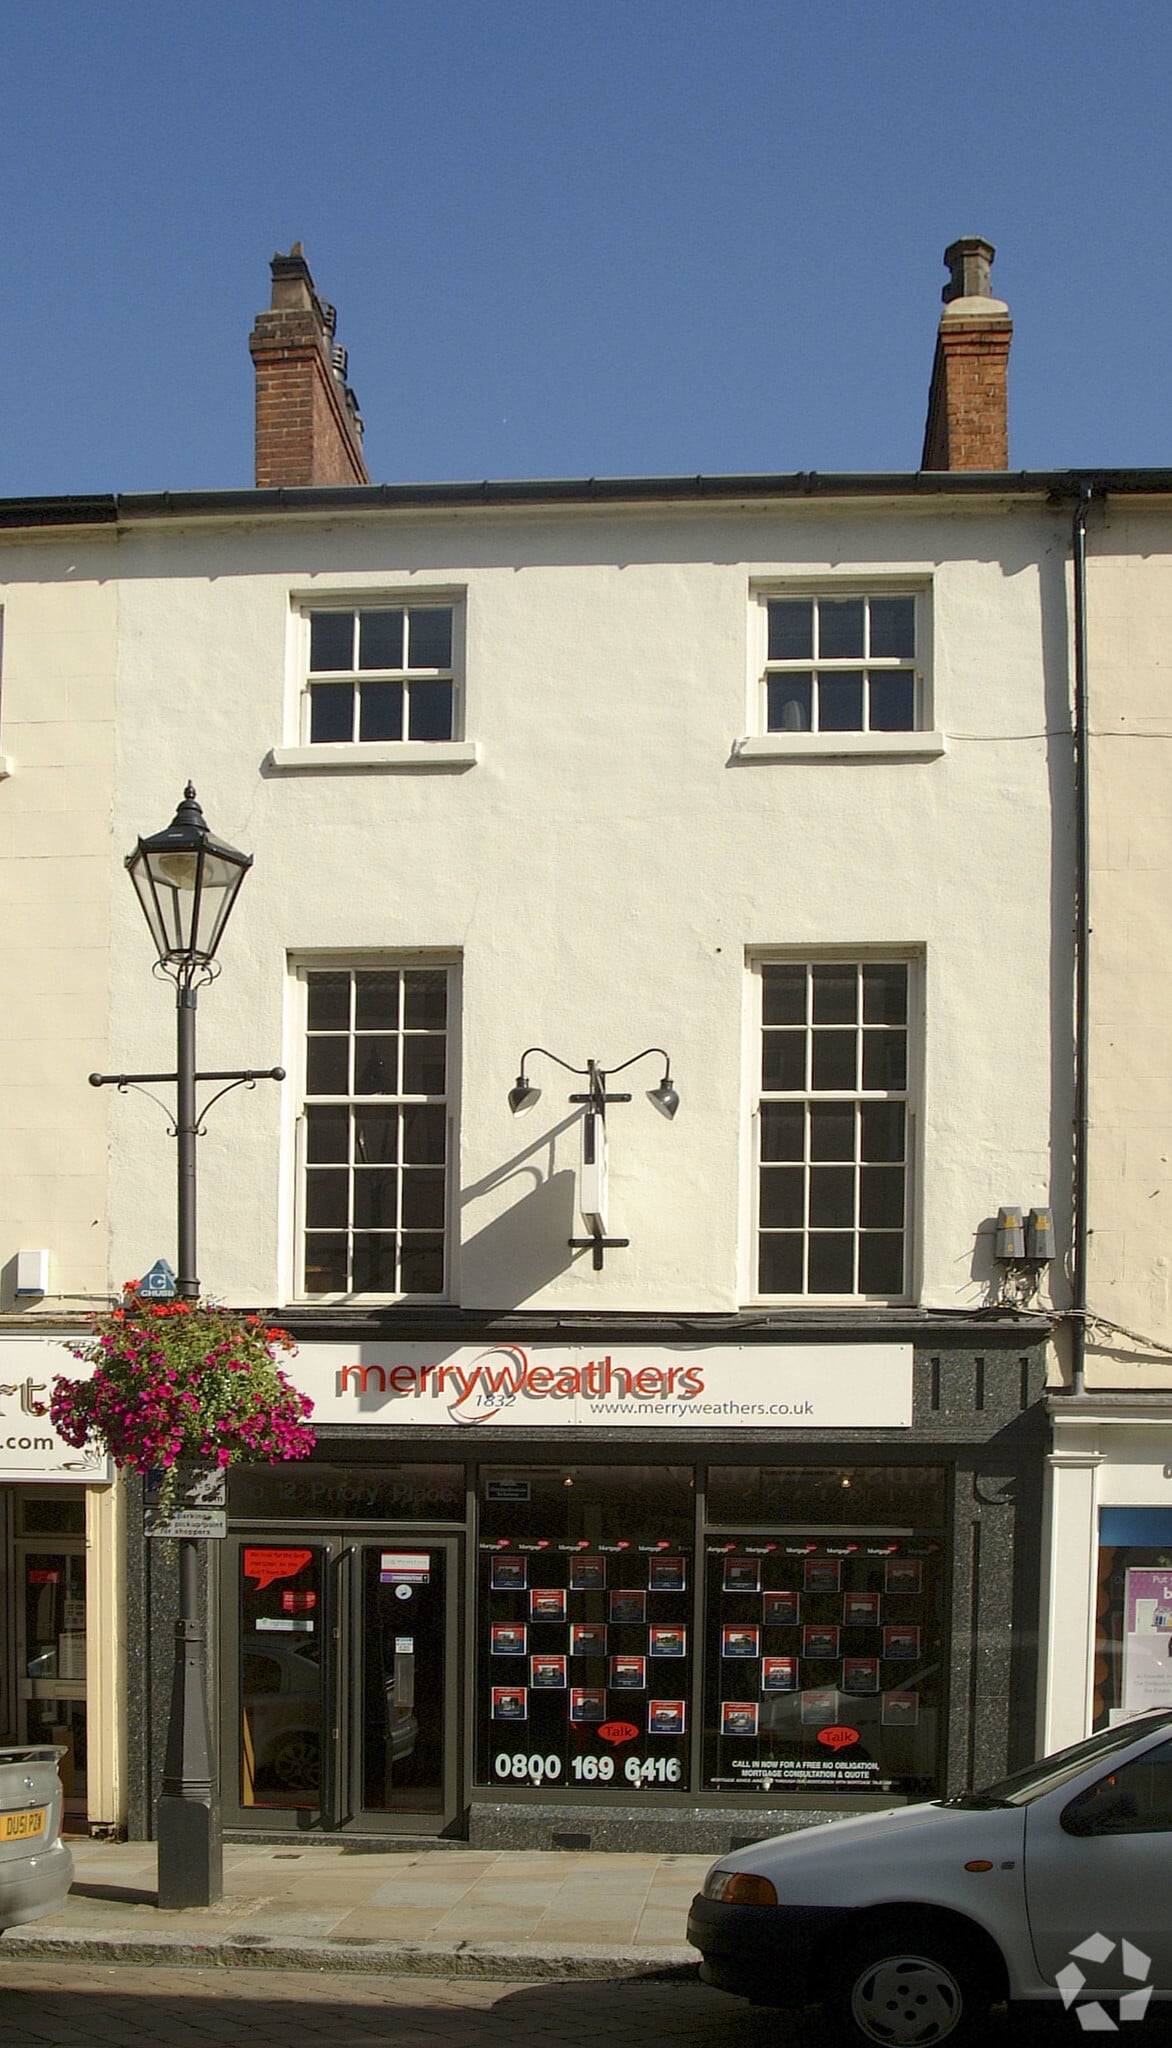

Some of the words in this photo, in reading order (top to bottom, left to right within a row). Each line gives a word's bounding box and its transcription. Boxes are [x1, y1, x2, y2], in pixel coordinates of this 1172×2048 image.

[340, 1350, 705, 1407] merryweathers
[475, 1394, 517, 1408] 1832
[590, 1400, 814, 1418] www.merryweathers.co.uk
[0, 1436, 54, 1451] .com
[604, 1725, 633, 1737] Talk
[824, 1730, 853, 1742] Talk
[494, 1753, 562, 1779] 0800
[571, 1755, 615, 1781] 169
[624, 1756, 682, 1783] 6416
[732, 1760, 751, 1768] CALL
[752, 1761, 760, 1769] IN
[761, 1761, 778, 1769] NOW
[779, 1761, 795, 1769] FOR
[795, 1761, 802, 1769] A
[802, 1761, 821, 1769] FREE
[822, 1762, 833, 1770] NO
[741, 1769, 782, 1777] MORTGAGE
[783, 1770, 836, 1778] CONSULTATION
[844, 1771, 870, 1779] QUOTE
